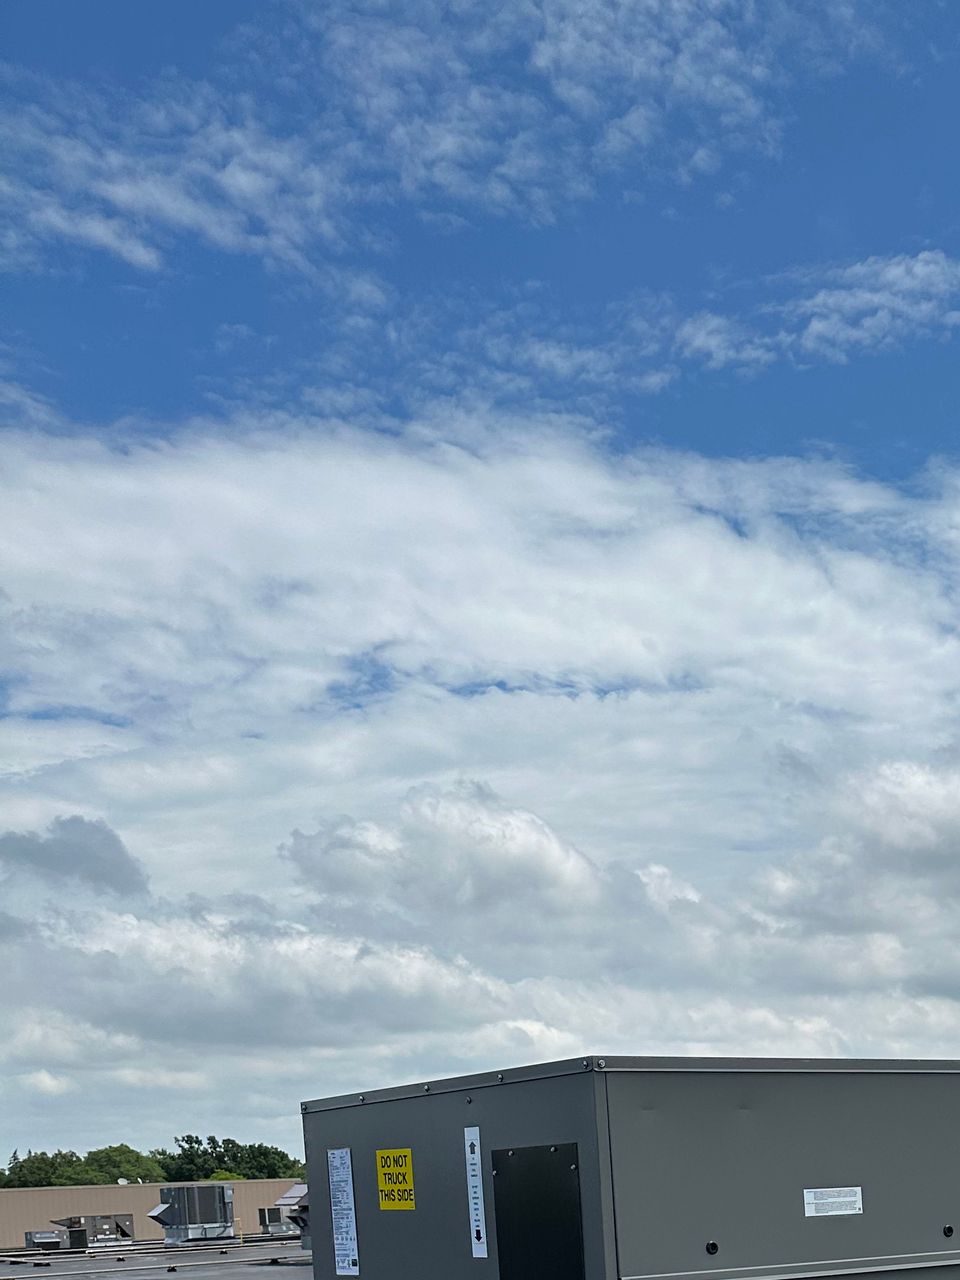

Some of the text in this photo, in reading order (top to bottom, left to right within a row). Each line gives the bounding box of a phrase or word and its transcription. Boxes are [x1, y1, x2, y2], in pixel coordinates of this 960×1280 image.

[381, 1154, 407, 1168] DO NOT
[383, 1172, 408, 1185] TRUCK
[380, 1188, 414, 1202] THIS SIDE
